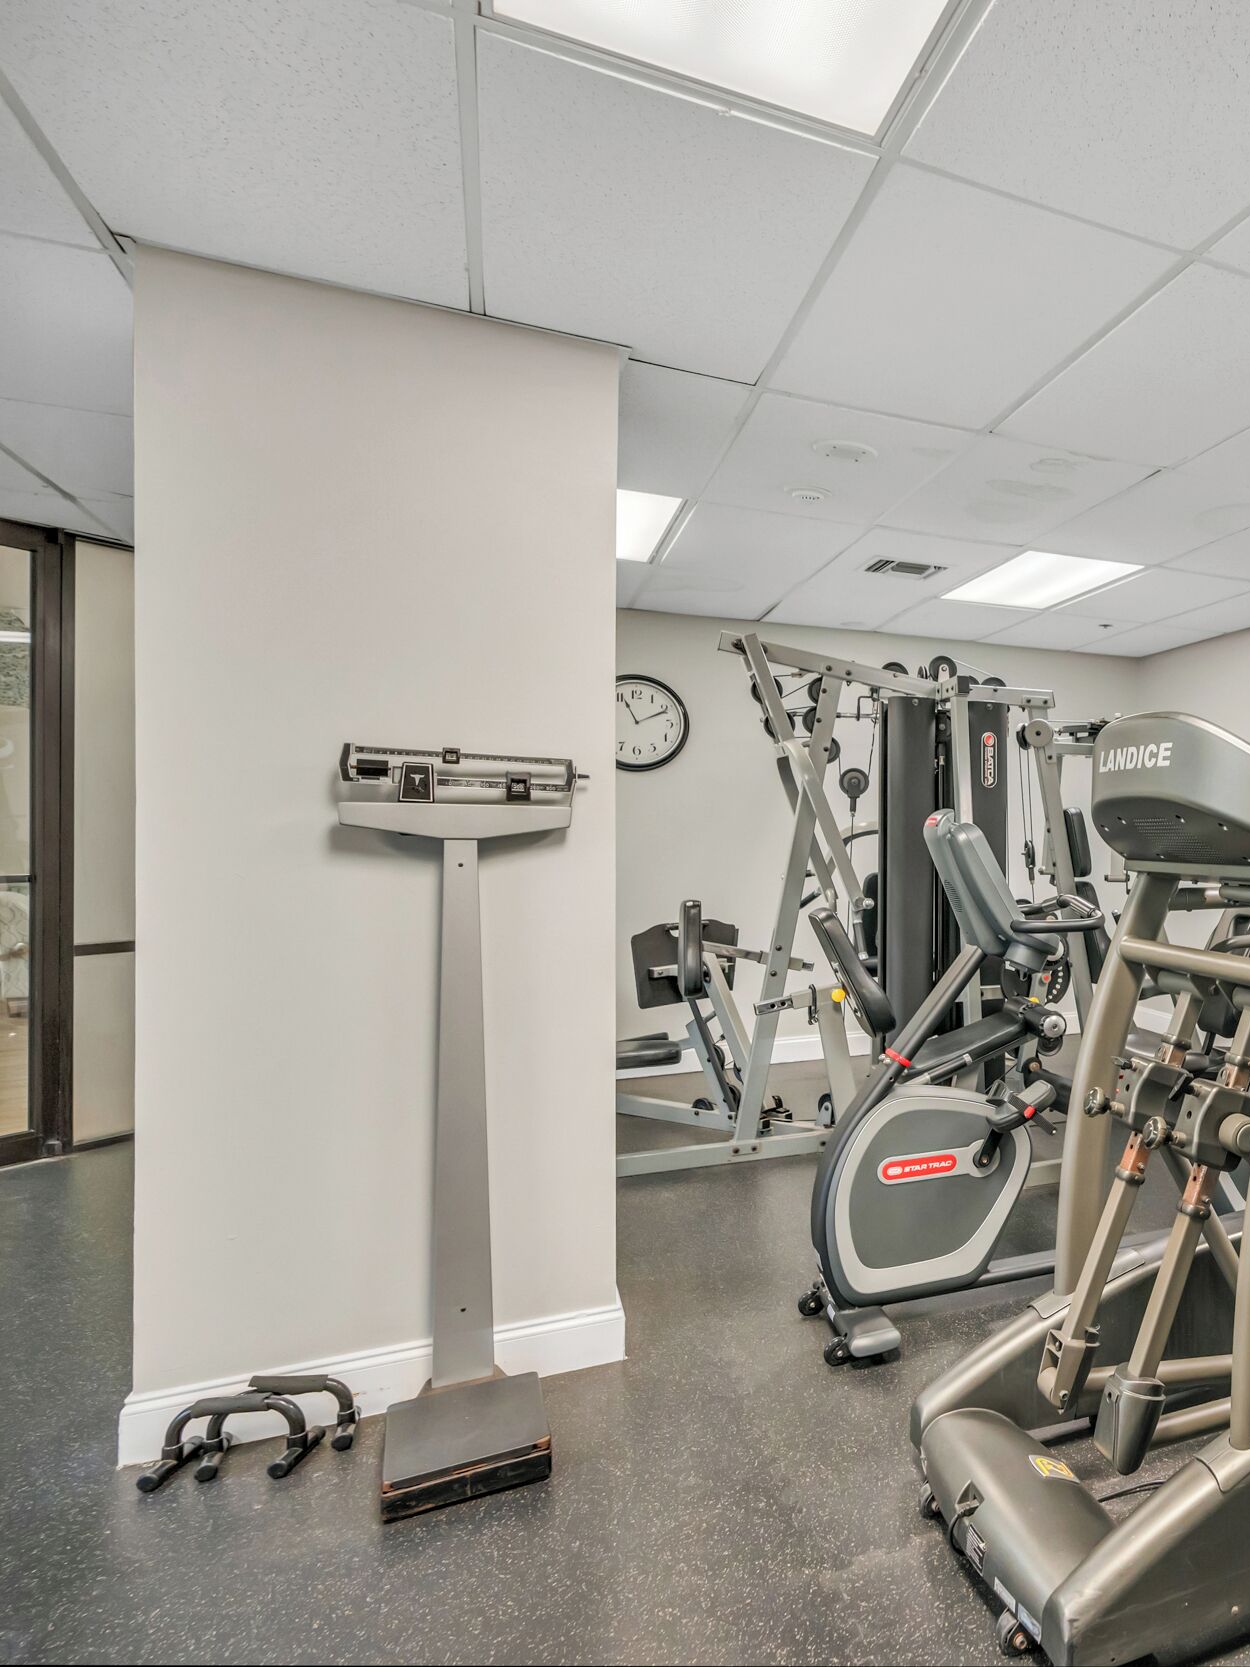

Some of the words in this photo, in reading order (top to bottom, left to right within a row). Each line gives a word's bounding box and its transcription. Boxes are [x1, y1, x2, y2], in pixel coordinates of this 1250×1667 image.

[631, 689, 642, 699] 12
[650, 694, 654, 704] 1
[660, 704, 669, 714] 2
[665, 719, 673, 728] 3
[618, 742, 625, 751] 7
[632, 745, 641, 755] 6
[649, 743, 657, 753] 5
[1098, 742, 1174, 774] LANDICE
[903, 1163, 927, 1173] STAR
[928, 1160, 953, 1169] TRAC
